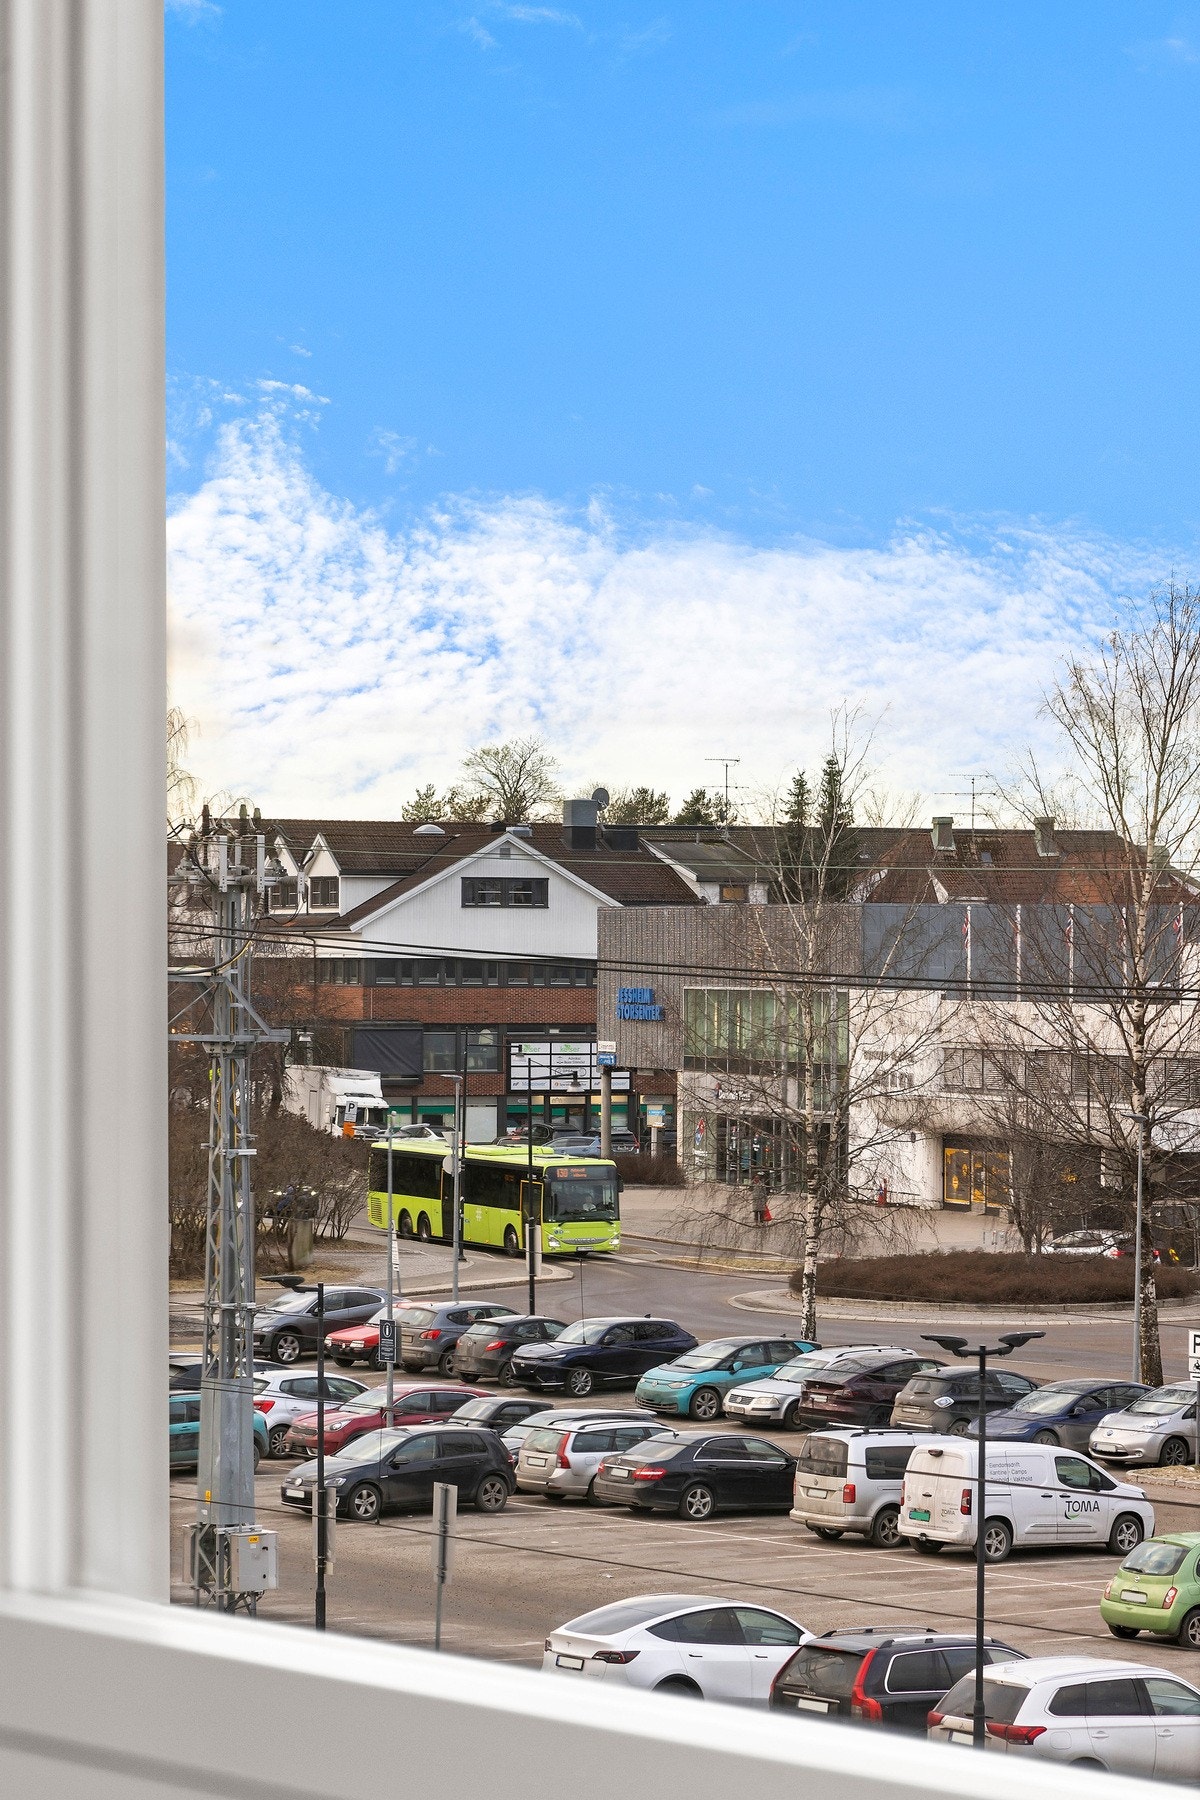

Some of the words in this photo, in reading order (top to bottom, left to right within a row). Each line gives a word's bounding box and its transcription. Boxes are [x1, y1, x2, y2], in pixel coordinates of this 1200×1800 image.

[617, 1004, 663, 1020] STORSENTER
[348, 1103, 355, 1112] P
[1065, 1501, 1100, 1512] TOMA
